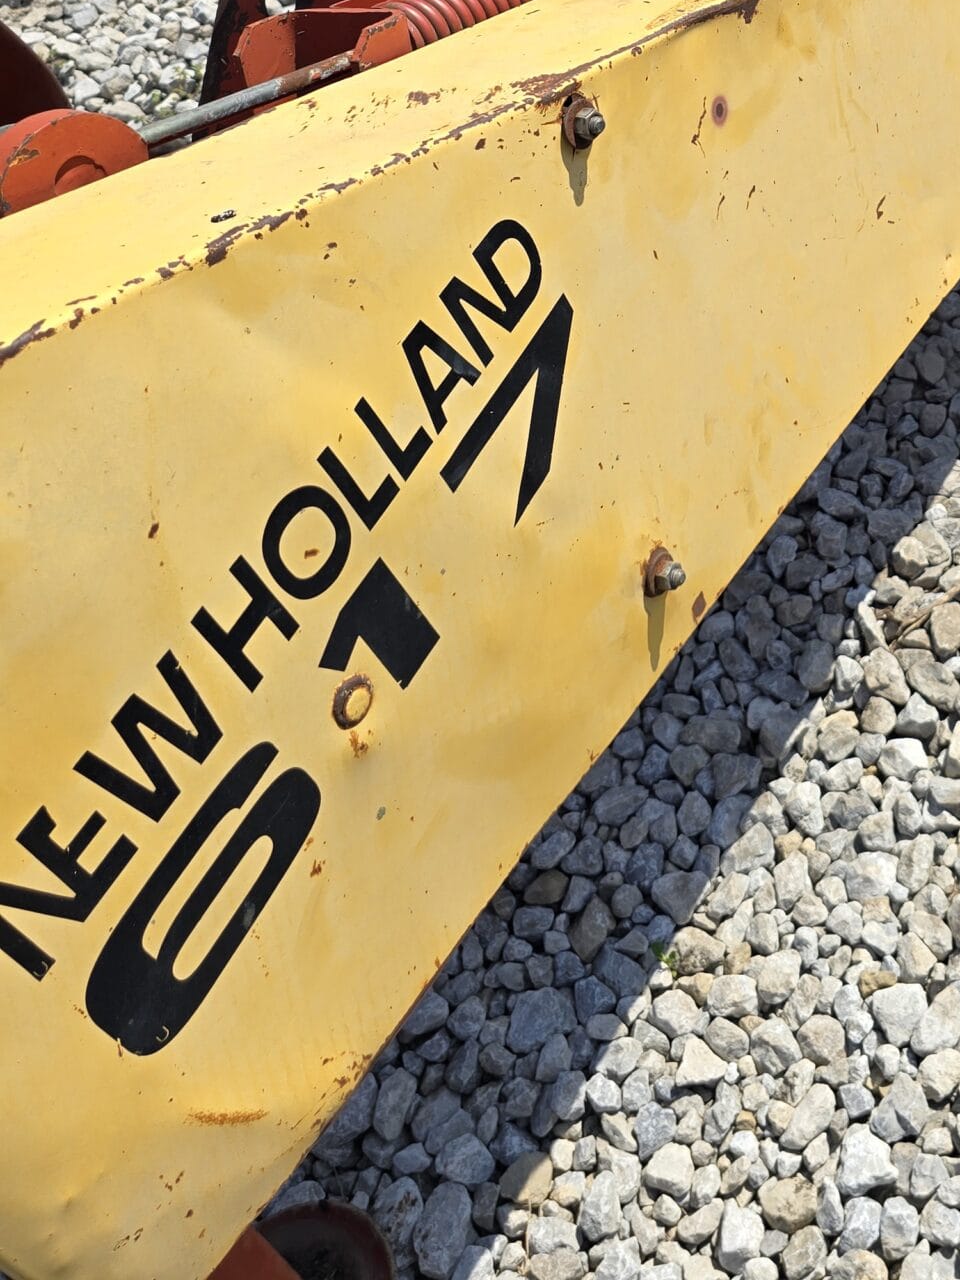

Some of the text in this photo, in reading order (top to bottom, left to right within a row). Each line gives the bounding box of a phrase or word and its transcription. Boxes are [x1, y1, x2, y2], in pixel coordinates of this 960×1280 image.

[0, 219, 543, 982] NEW HOLLAND
[85, 293, 574, 1056] 617
